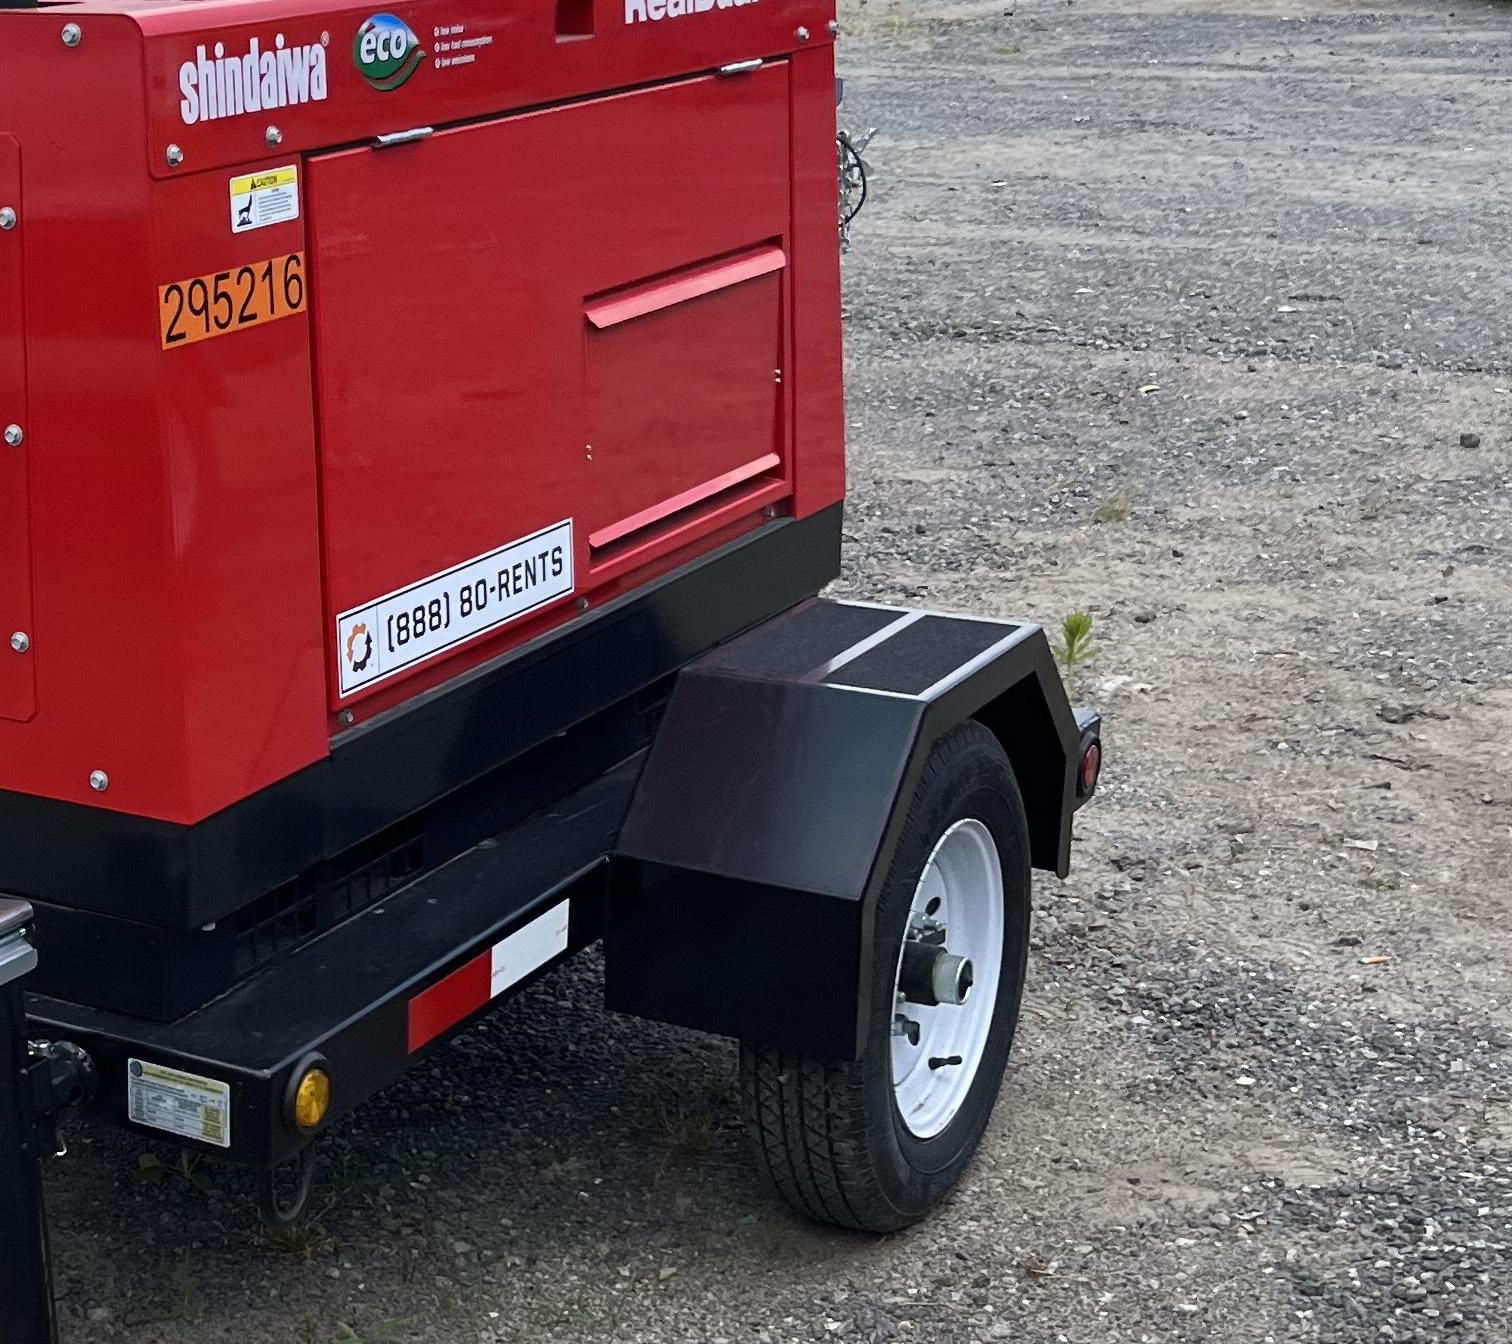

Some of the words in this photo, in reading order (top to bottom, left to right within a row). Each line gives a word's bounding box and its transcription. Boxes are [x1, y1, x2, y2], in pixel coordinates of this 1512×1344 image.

[179, 32, 328, 125] shindaiwa
[164, 254, 303, 344] 295216
[387, 592, 450, 652] (888)
[460, 545, 563, 618] 80-RENTS
